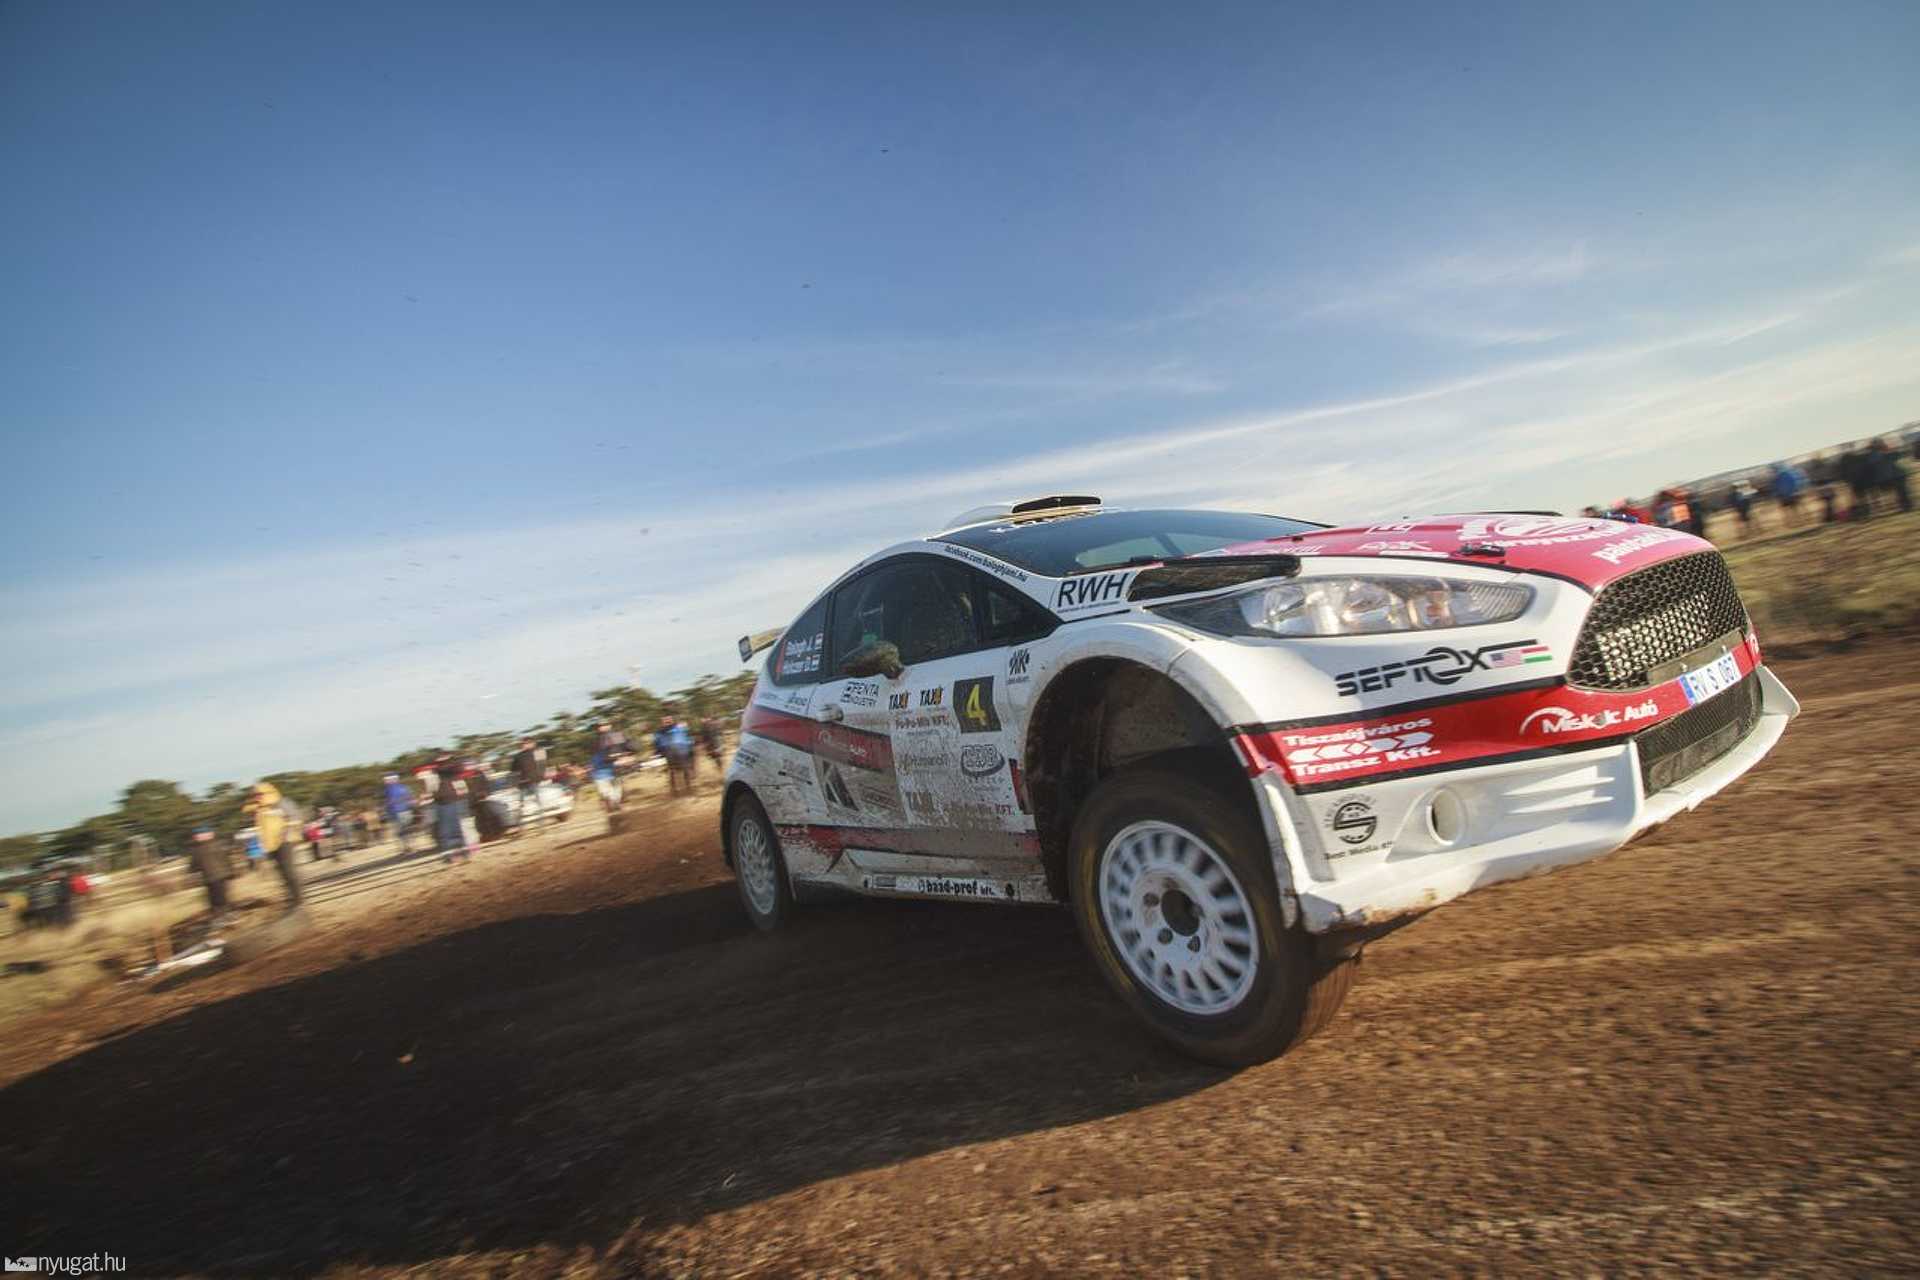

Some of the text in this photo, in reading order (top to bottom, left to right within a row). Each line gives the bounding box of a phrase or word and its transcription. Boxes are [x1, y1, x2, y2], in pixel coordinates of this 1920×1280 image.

[1057, 572, 1130, 607] RWH
[962, 683, 988, 727] 4
[1289, 746, 1442, 777] Transz Kft.
